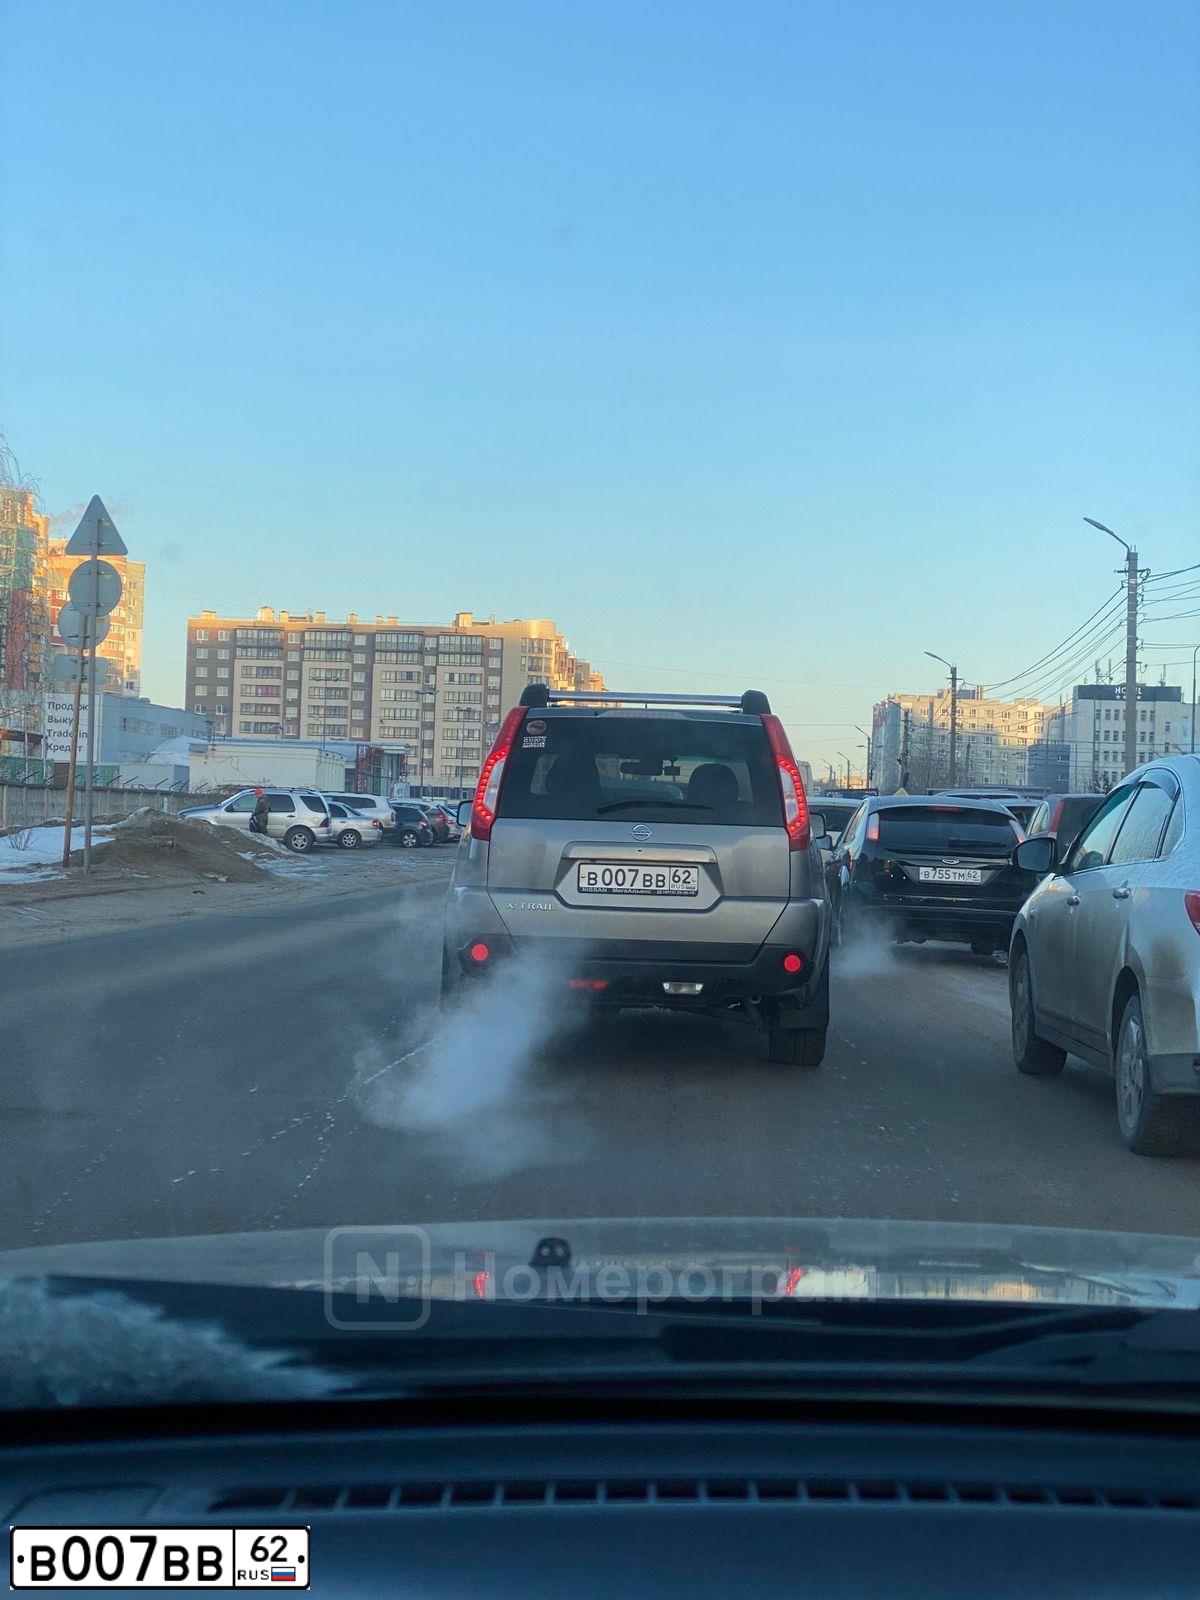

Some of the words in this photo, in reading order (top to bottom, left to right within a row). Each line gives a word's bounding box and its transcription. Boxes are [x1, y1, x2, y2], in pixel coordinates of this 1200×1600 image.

[1115, 686, 1142, 695] HOL
[47, 701, 89, 711] Продж
[47, 715, 75, 726] Выку
[46, 743, 83, 752] Кредт
[587, 868, 666, 888] В007ВВ
[671, 869, 692, 884] 62
